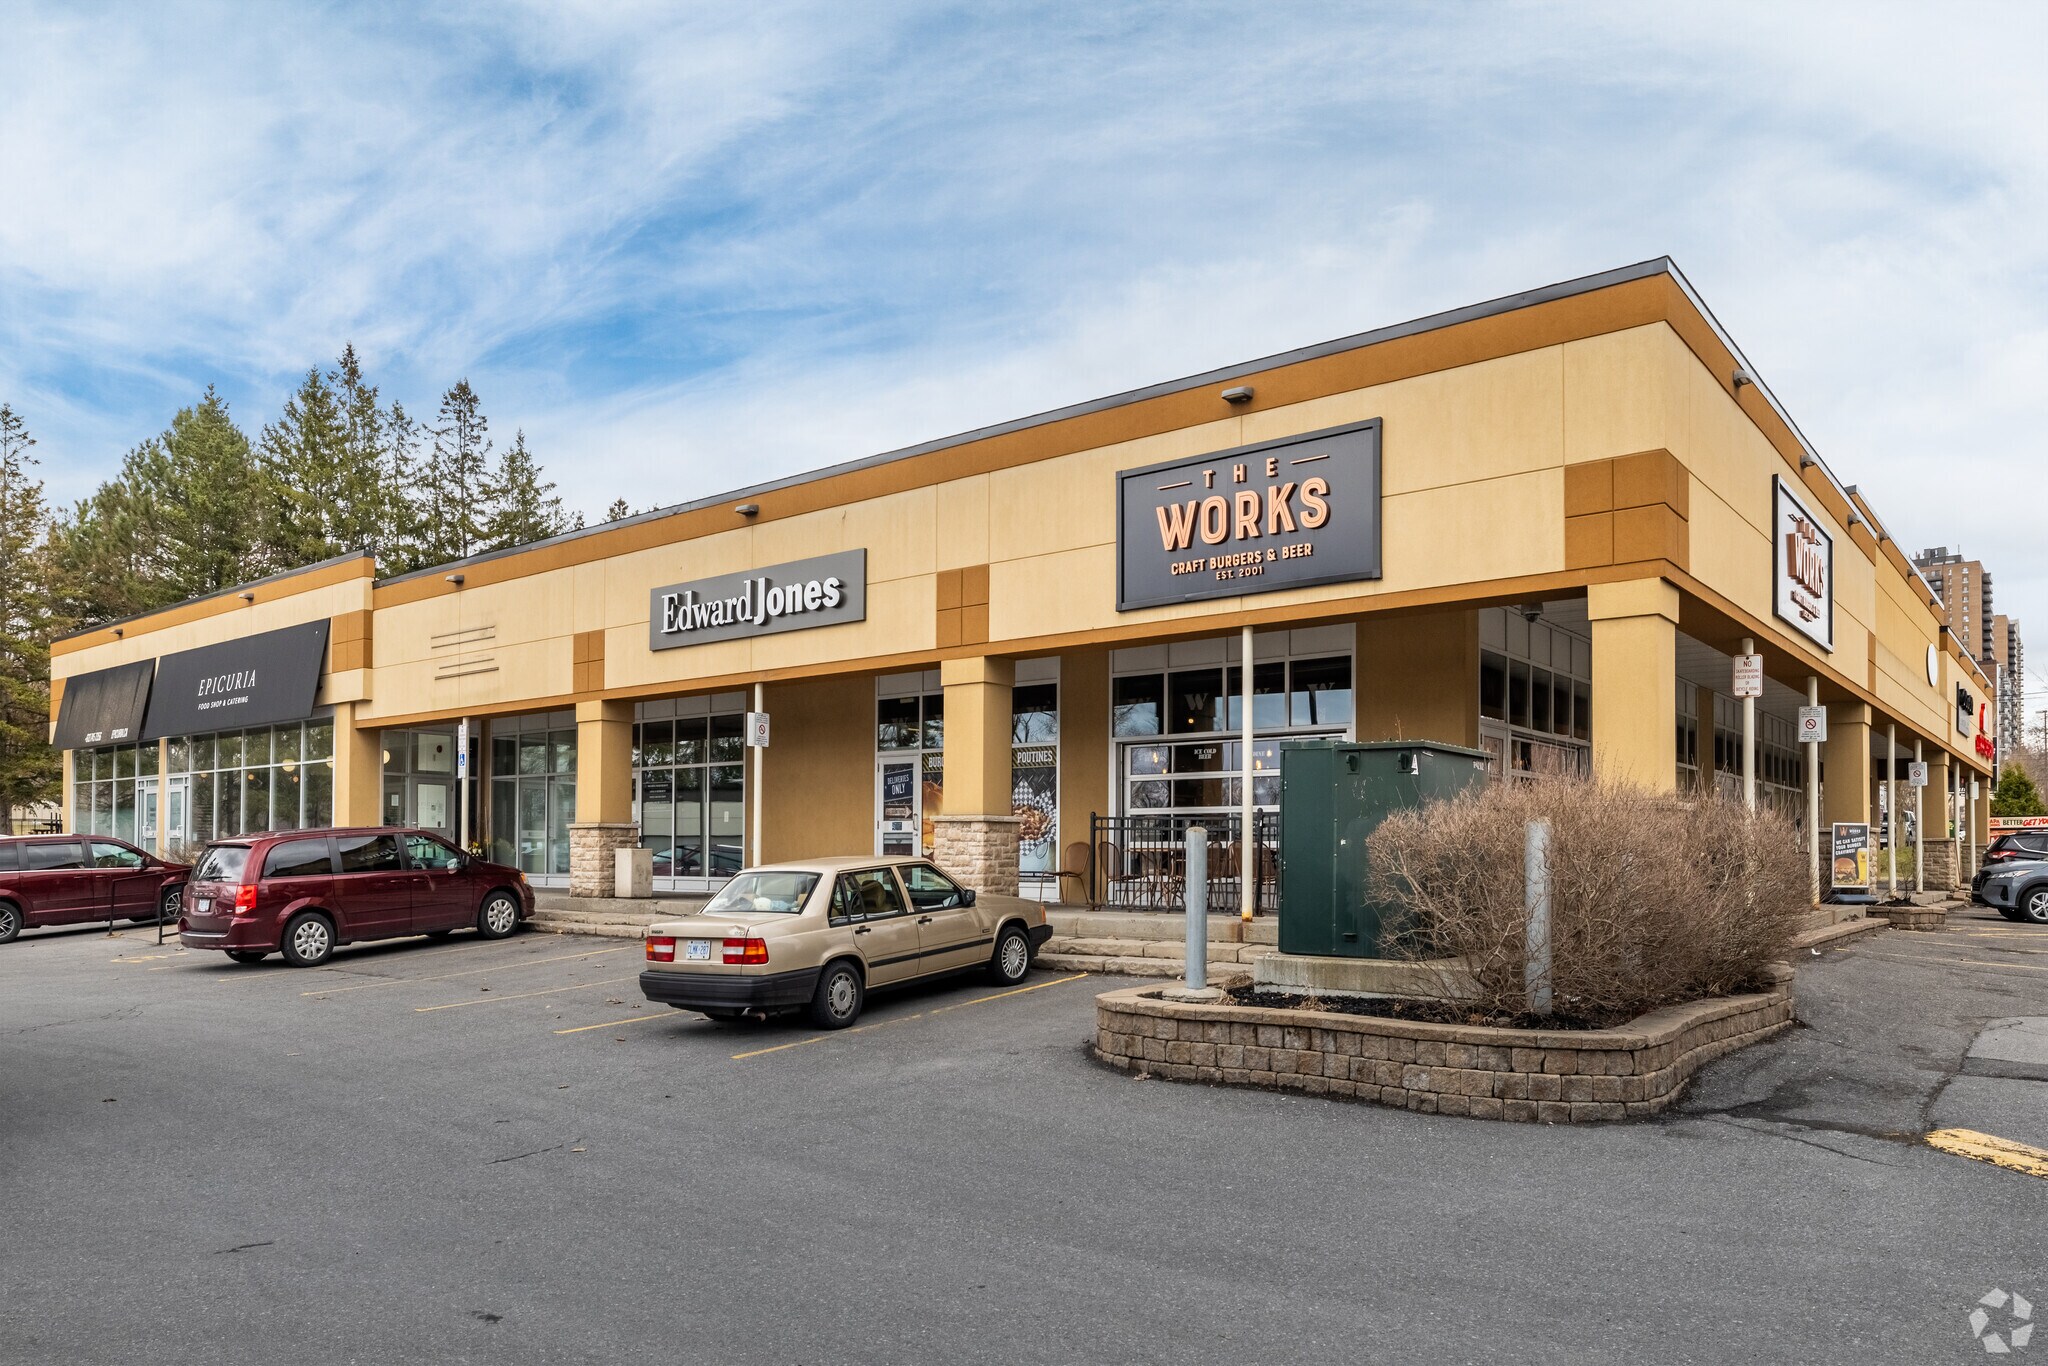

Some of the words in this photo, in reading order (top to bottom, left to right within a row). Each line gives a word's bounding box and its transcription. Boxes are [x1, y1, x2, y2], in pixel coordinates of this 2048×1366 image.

[1203, 457, 1278, 488] THE
[1155, 477, 1331, 552] WORKS
[1171, 558, 1206, 576] CRAFT
[1209, 550, 1263, 571] BURGERS
[1266, 548, 1277, 562] &
[1282, 543, 1314, 560] BEER
[1215, 571, 1235, 581] EST.
[1238, 565, 1264, 577] 2001
[660, 580, 753, 633] Edward
[753, 576, 842, 625] Jones
[1743, 660, 1753, 668] NO
[197, 669, 256, 697] EPICURIA
[210, 700, 222, 709] SHOP
[1017, 750, 1053, 764] POUTINES
[887, 774, 910, 785] DELIVERIES
[891, 783, 906, 795] ONLY
[2022, 818, 2037, 827] GET
